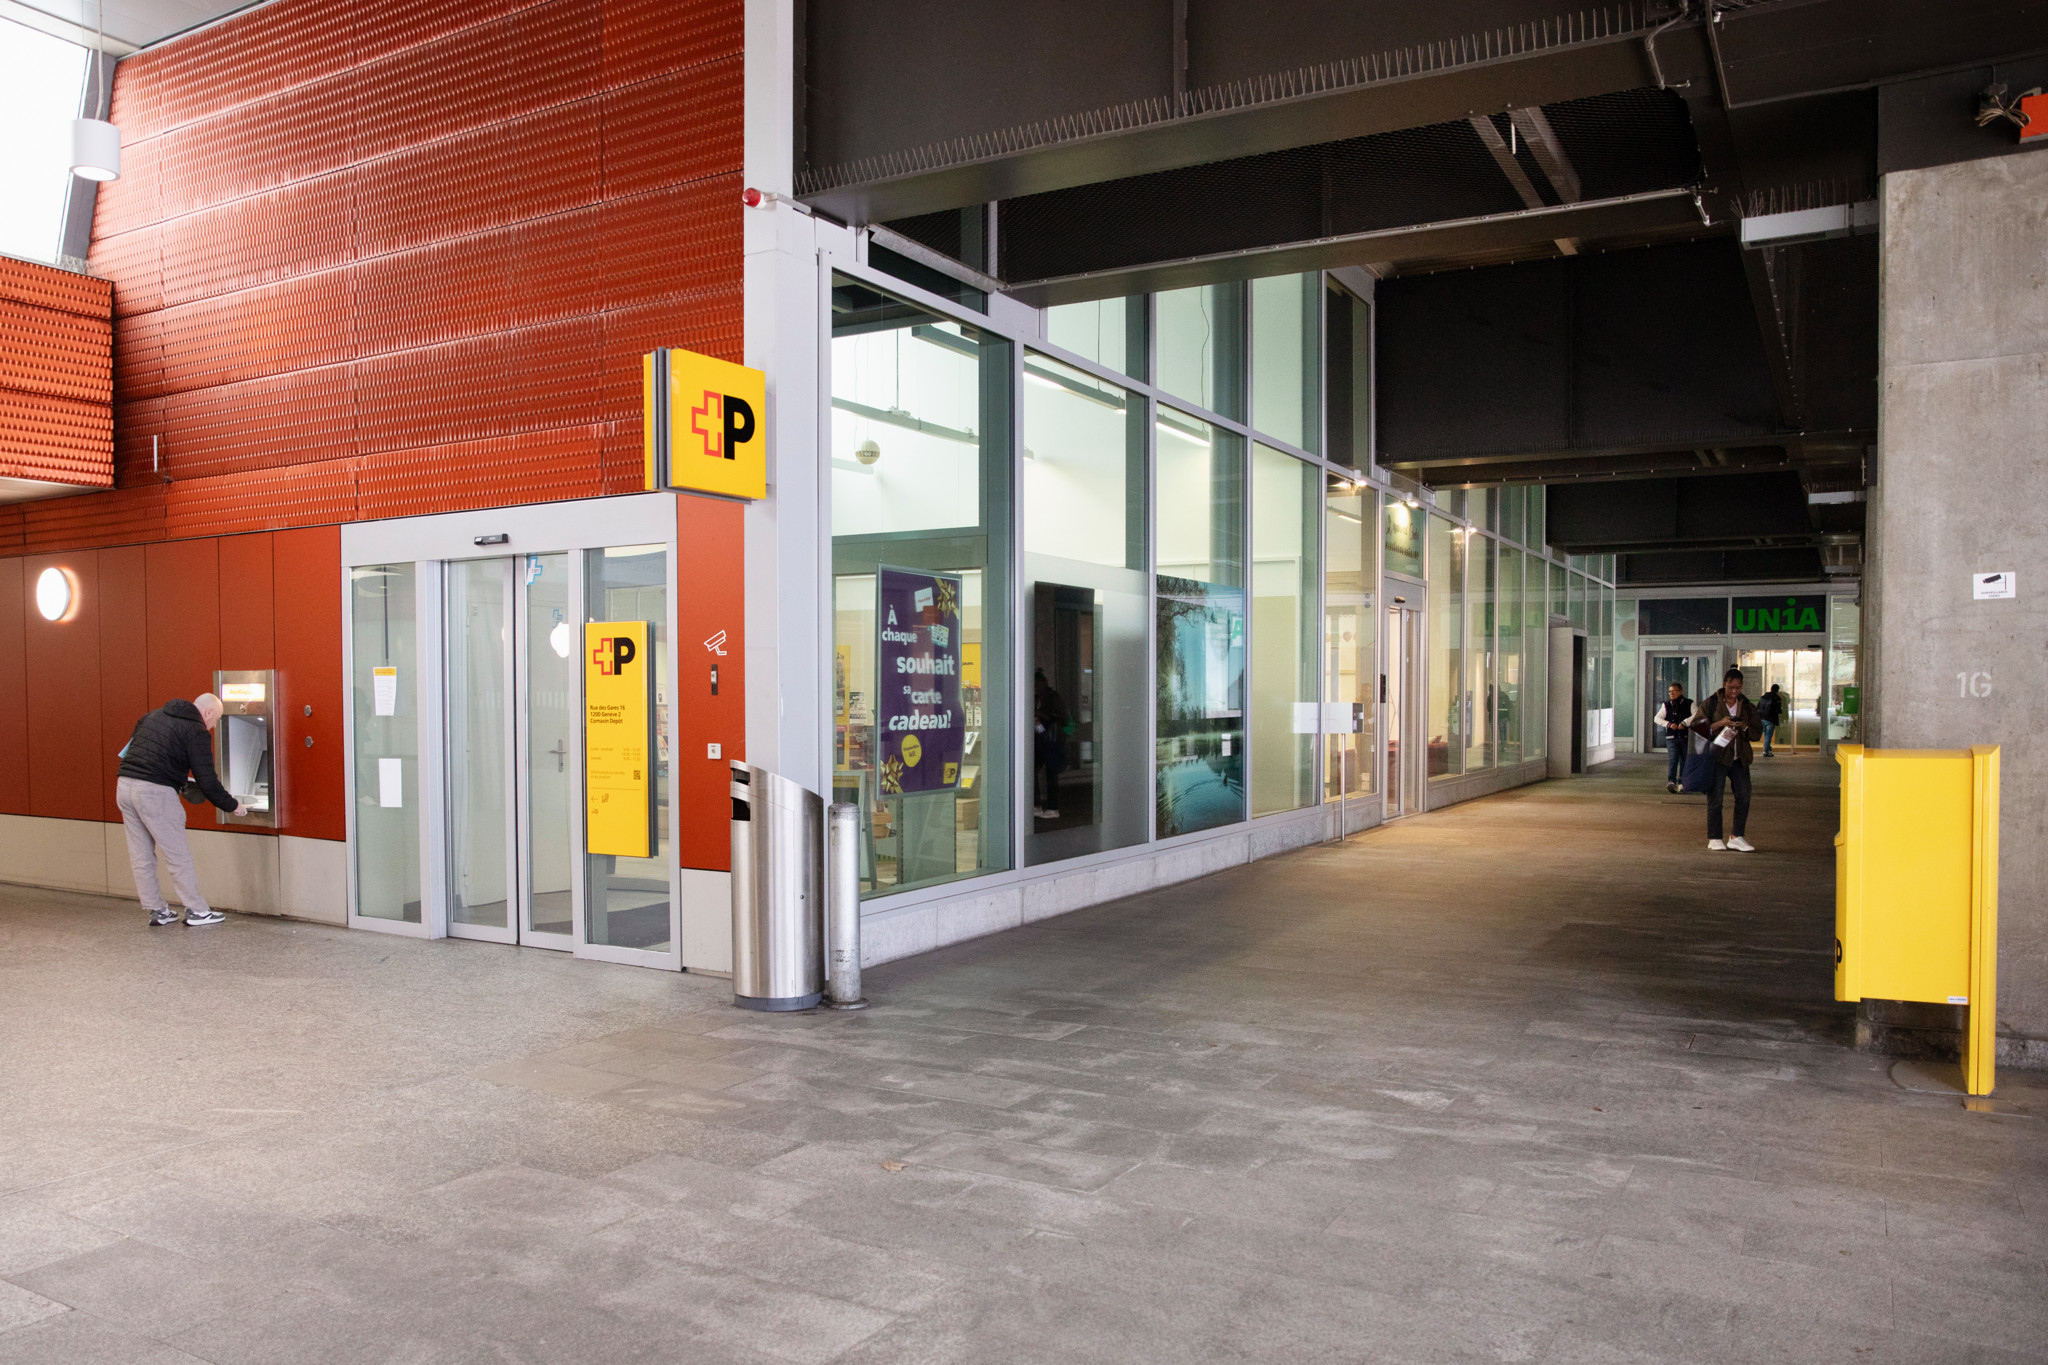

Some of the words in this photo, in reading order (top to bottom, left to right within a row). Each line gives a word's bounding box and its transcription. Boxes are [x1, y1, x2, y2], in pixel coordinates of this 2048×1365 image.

[887, 605, 898, 626] À
[882, 628, 918, 645] chaque
[897, 652, 955, 675] souhait
[903, 685, 911, 695] sa
[911, 690, 942, 704] carte
[1956, 671, 1992, 698] 1G
[888, 710, 952, 731] cadeau!
